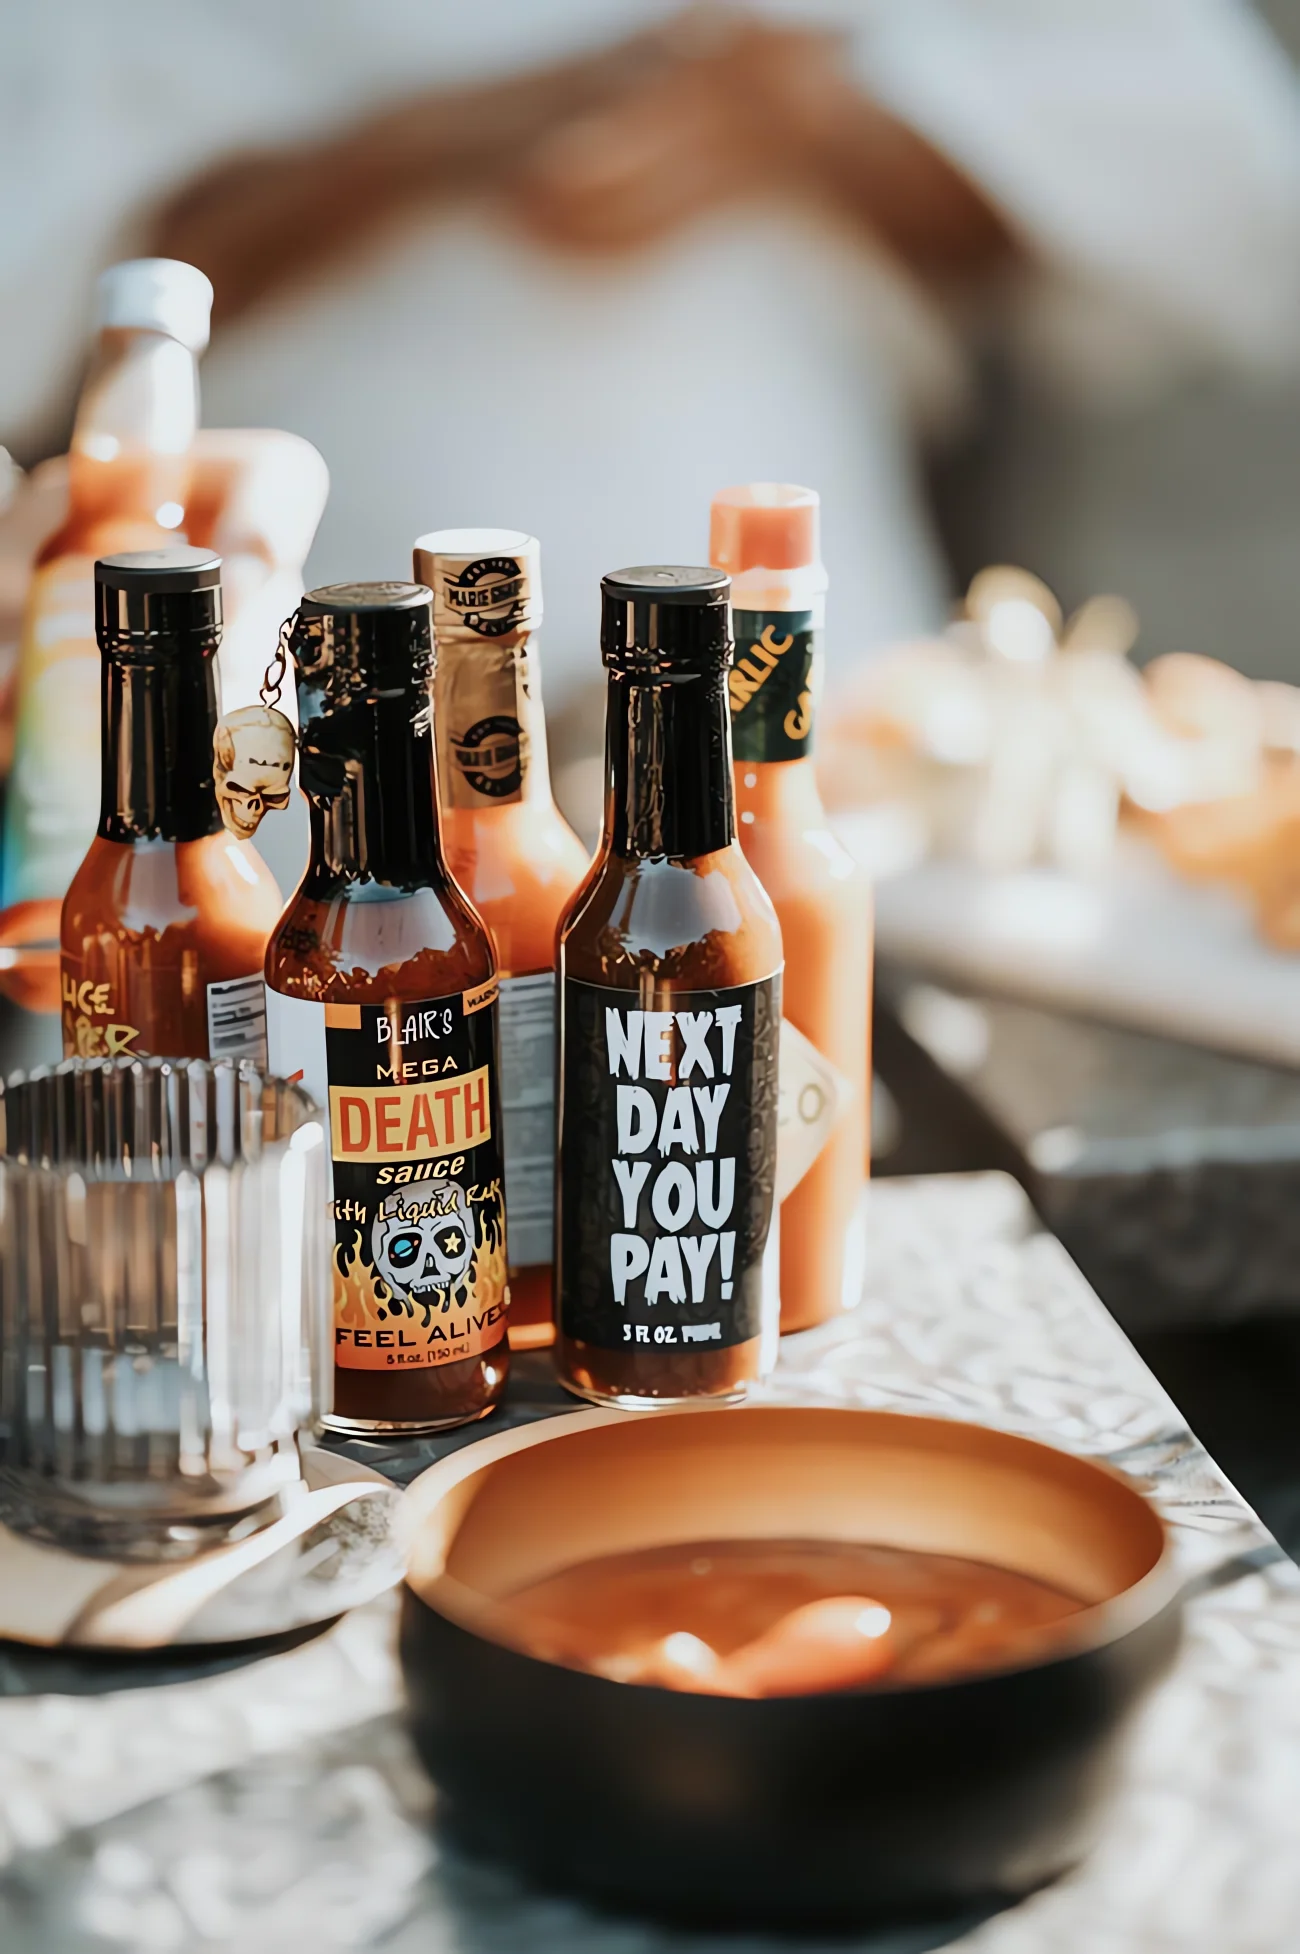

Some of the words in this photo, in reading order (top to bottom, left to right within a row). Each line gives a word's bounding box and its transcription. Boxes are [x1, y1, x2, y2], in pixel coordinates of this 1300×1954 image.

[376, 1008, 453, 1045] BLAIR'S
[605, 1004, 742, 1081] NEXT
[376, 1056, 459, 1081] MEGA
[339, 1077, 487, 1153] DEATH
[616, 1083, 731, 1158] DAY
[376, 1155, 465, 1185] sauce
[378, 1190, 458, 1225] Liquid
[611, 1157, 736, 1232] YOU
[610, 1231, 736, 1305] PAY!
[336, 1327, 417, 1348] FEEL
[654, 1325, 677, 1343] OZ
